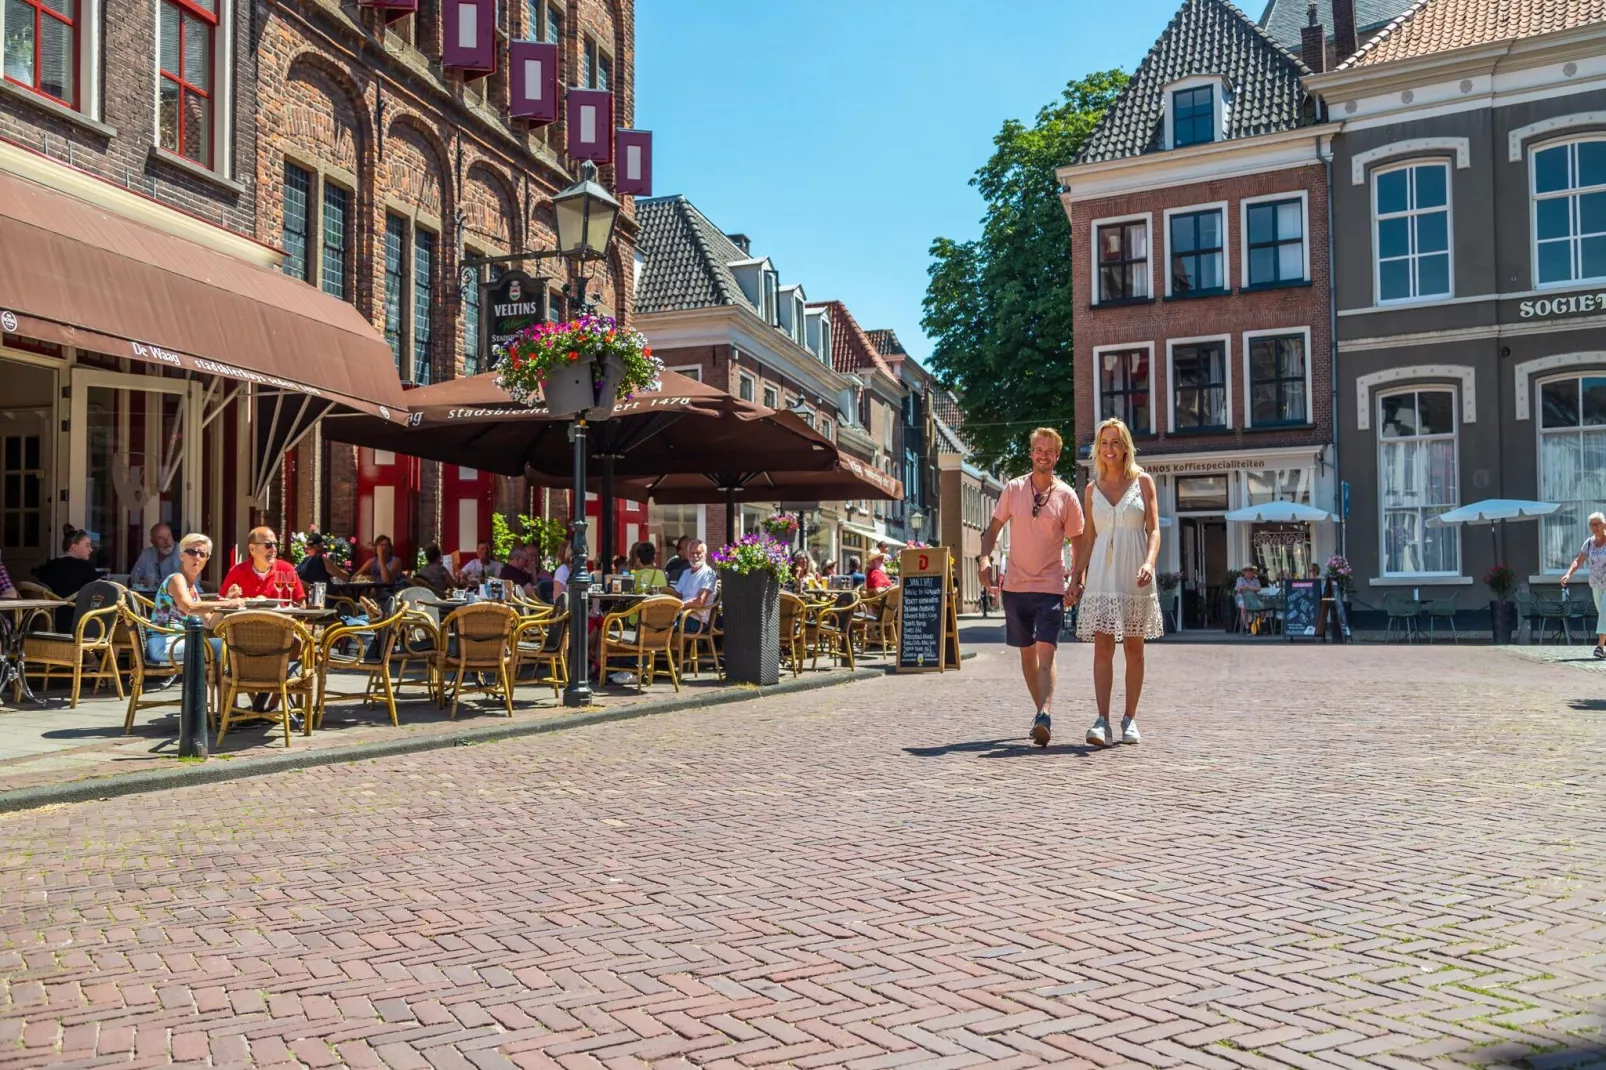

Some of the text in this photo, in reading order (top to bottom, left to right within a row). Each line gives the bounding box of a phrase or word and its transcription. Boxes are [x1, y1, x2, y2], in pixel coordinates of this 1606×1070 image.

[494, 302, 537, 317] VELTINS
[1520, 293, 1606, 318] SOCIET
[132, 341, 149, 357] De
[149, 345, 181, 367] Waag
[194, 359, 267, 383] stadsbierhuys
[408, 397, 691, 427] ag stadsbierhu ert 1478
[1173, 459, 1265, 473] Koffiespecialiteiten
